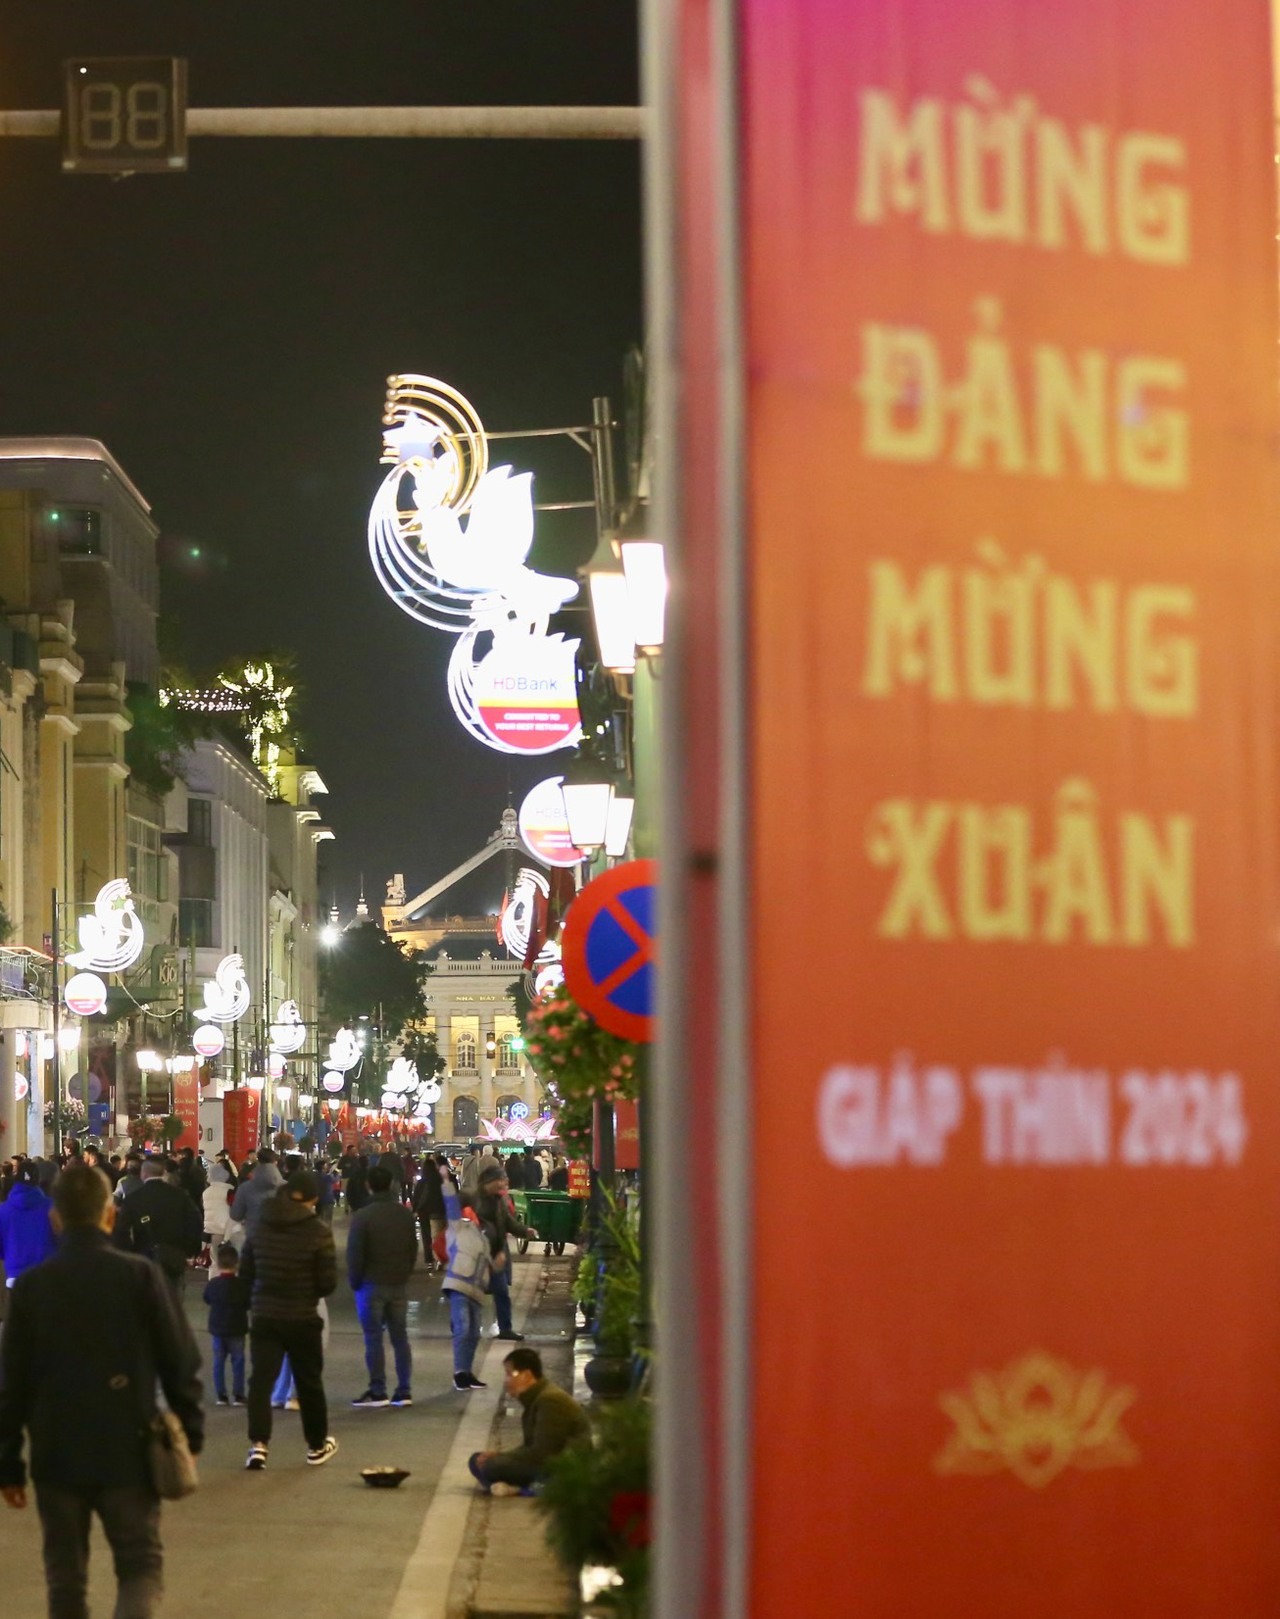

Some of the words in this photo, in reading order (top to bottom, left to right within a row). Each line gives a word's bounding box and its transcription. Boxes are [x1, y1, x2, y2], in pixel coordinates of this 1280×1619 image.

[856, 75, 1190, 265] MỪNG
[855, 296, 1190, 490] ĐẢNG
[493, 677, 558, 691] HDBank
[862, 537, 1198, 718] MỪNG
[866, 777, 1196, 948] XUÂN
[817, 1050, 963, 1169] GIÁP
[973, 1048, 1111, 1168] THÌN
[1122, 1066, 1247, 1168] 2024
